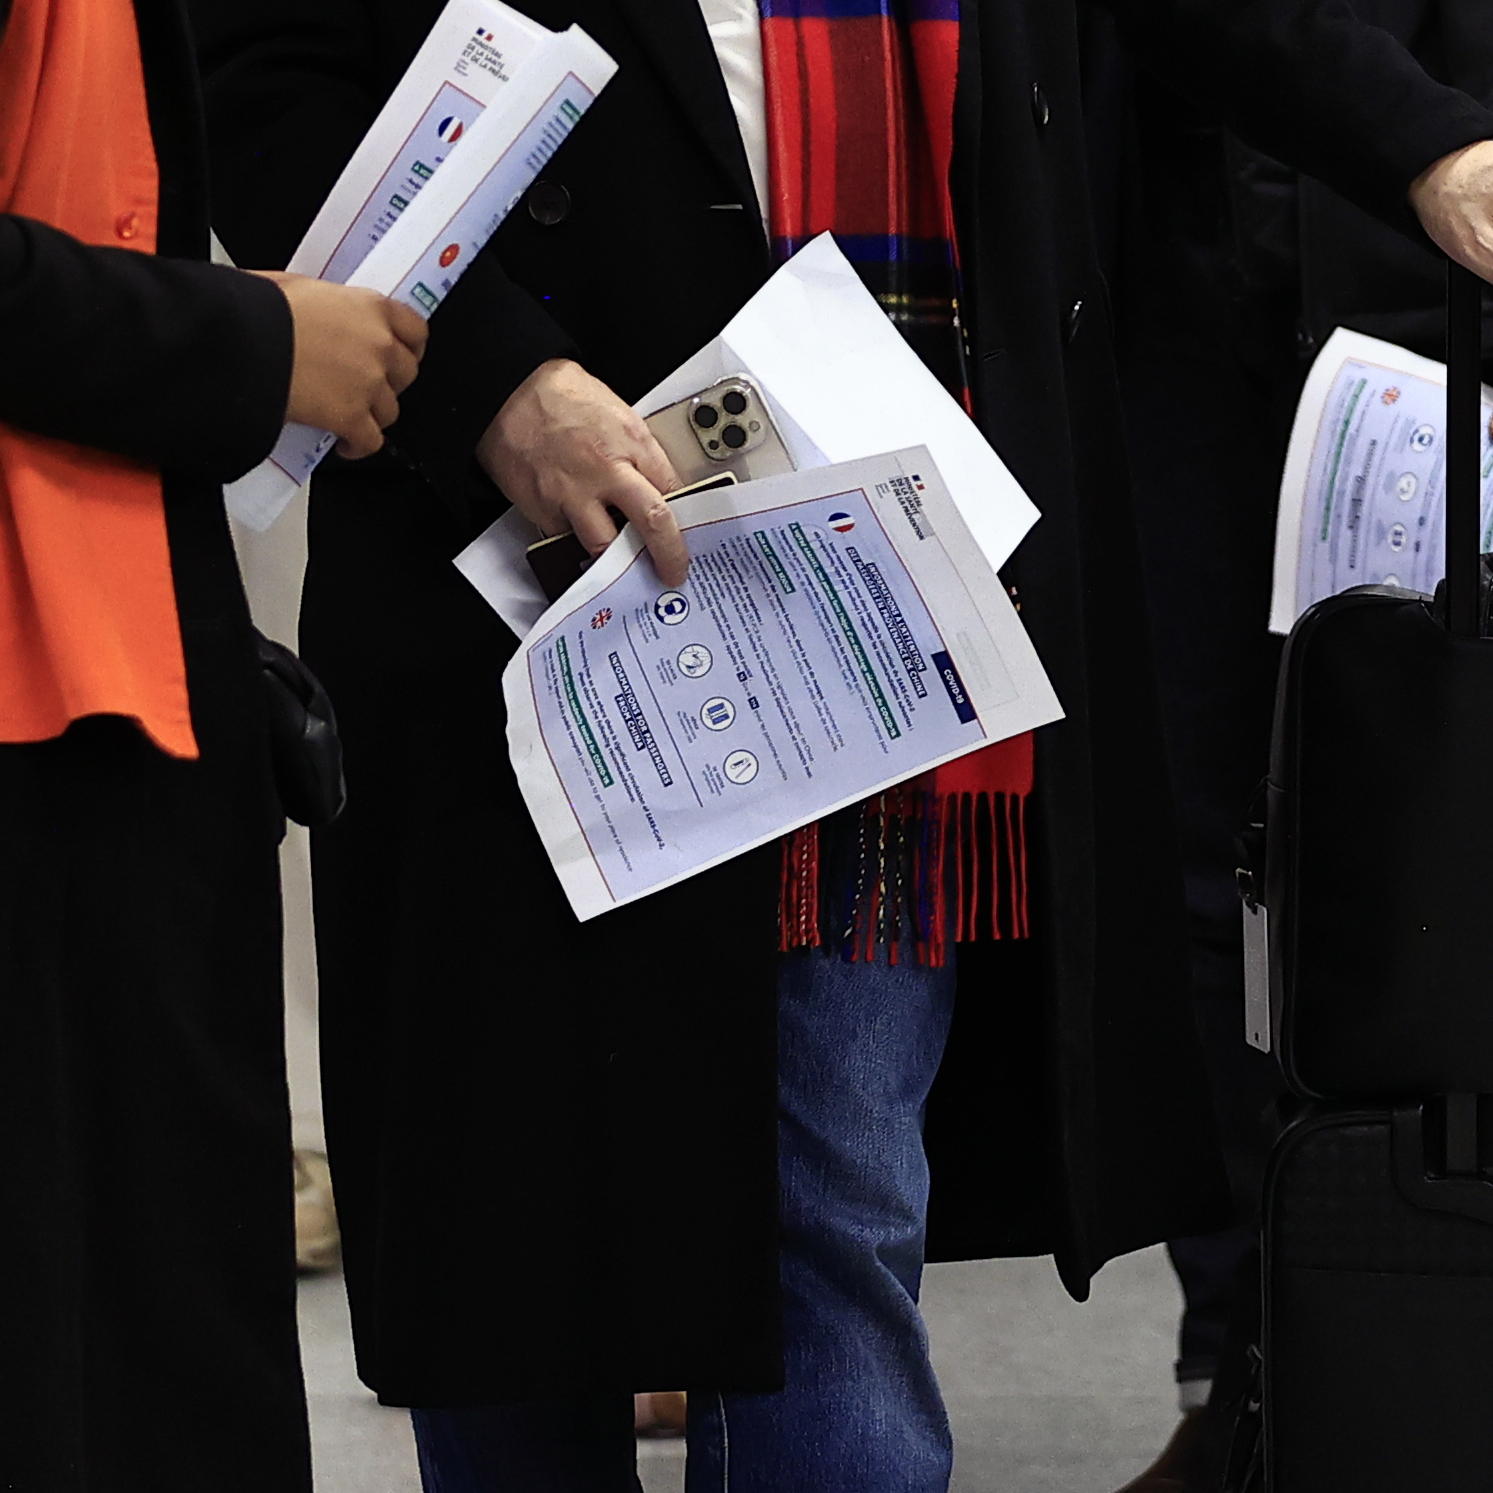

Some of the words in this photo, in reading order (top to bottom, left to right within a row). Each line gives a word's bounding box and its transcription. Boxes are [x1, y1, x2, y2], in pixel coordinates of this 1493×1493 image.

[897, 496, 906, 505] LA
[900, 486, 909, 495] LA
[878, 608, 908, 658] PROVENANCE
[903, 658, 914, 669] DE
[909, 670, 925, 695] CHINE
[943, 668, 964, 703] COVID-19
[610, 654, 640, 714] INFORMATIONS
[635, 714, 647, 732] FOR
[644, 732, 670, 783] PASSENGERS
[616, 696, 631, 720] FROM
[627, 720, 643, 748] CHINA
